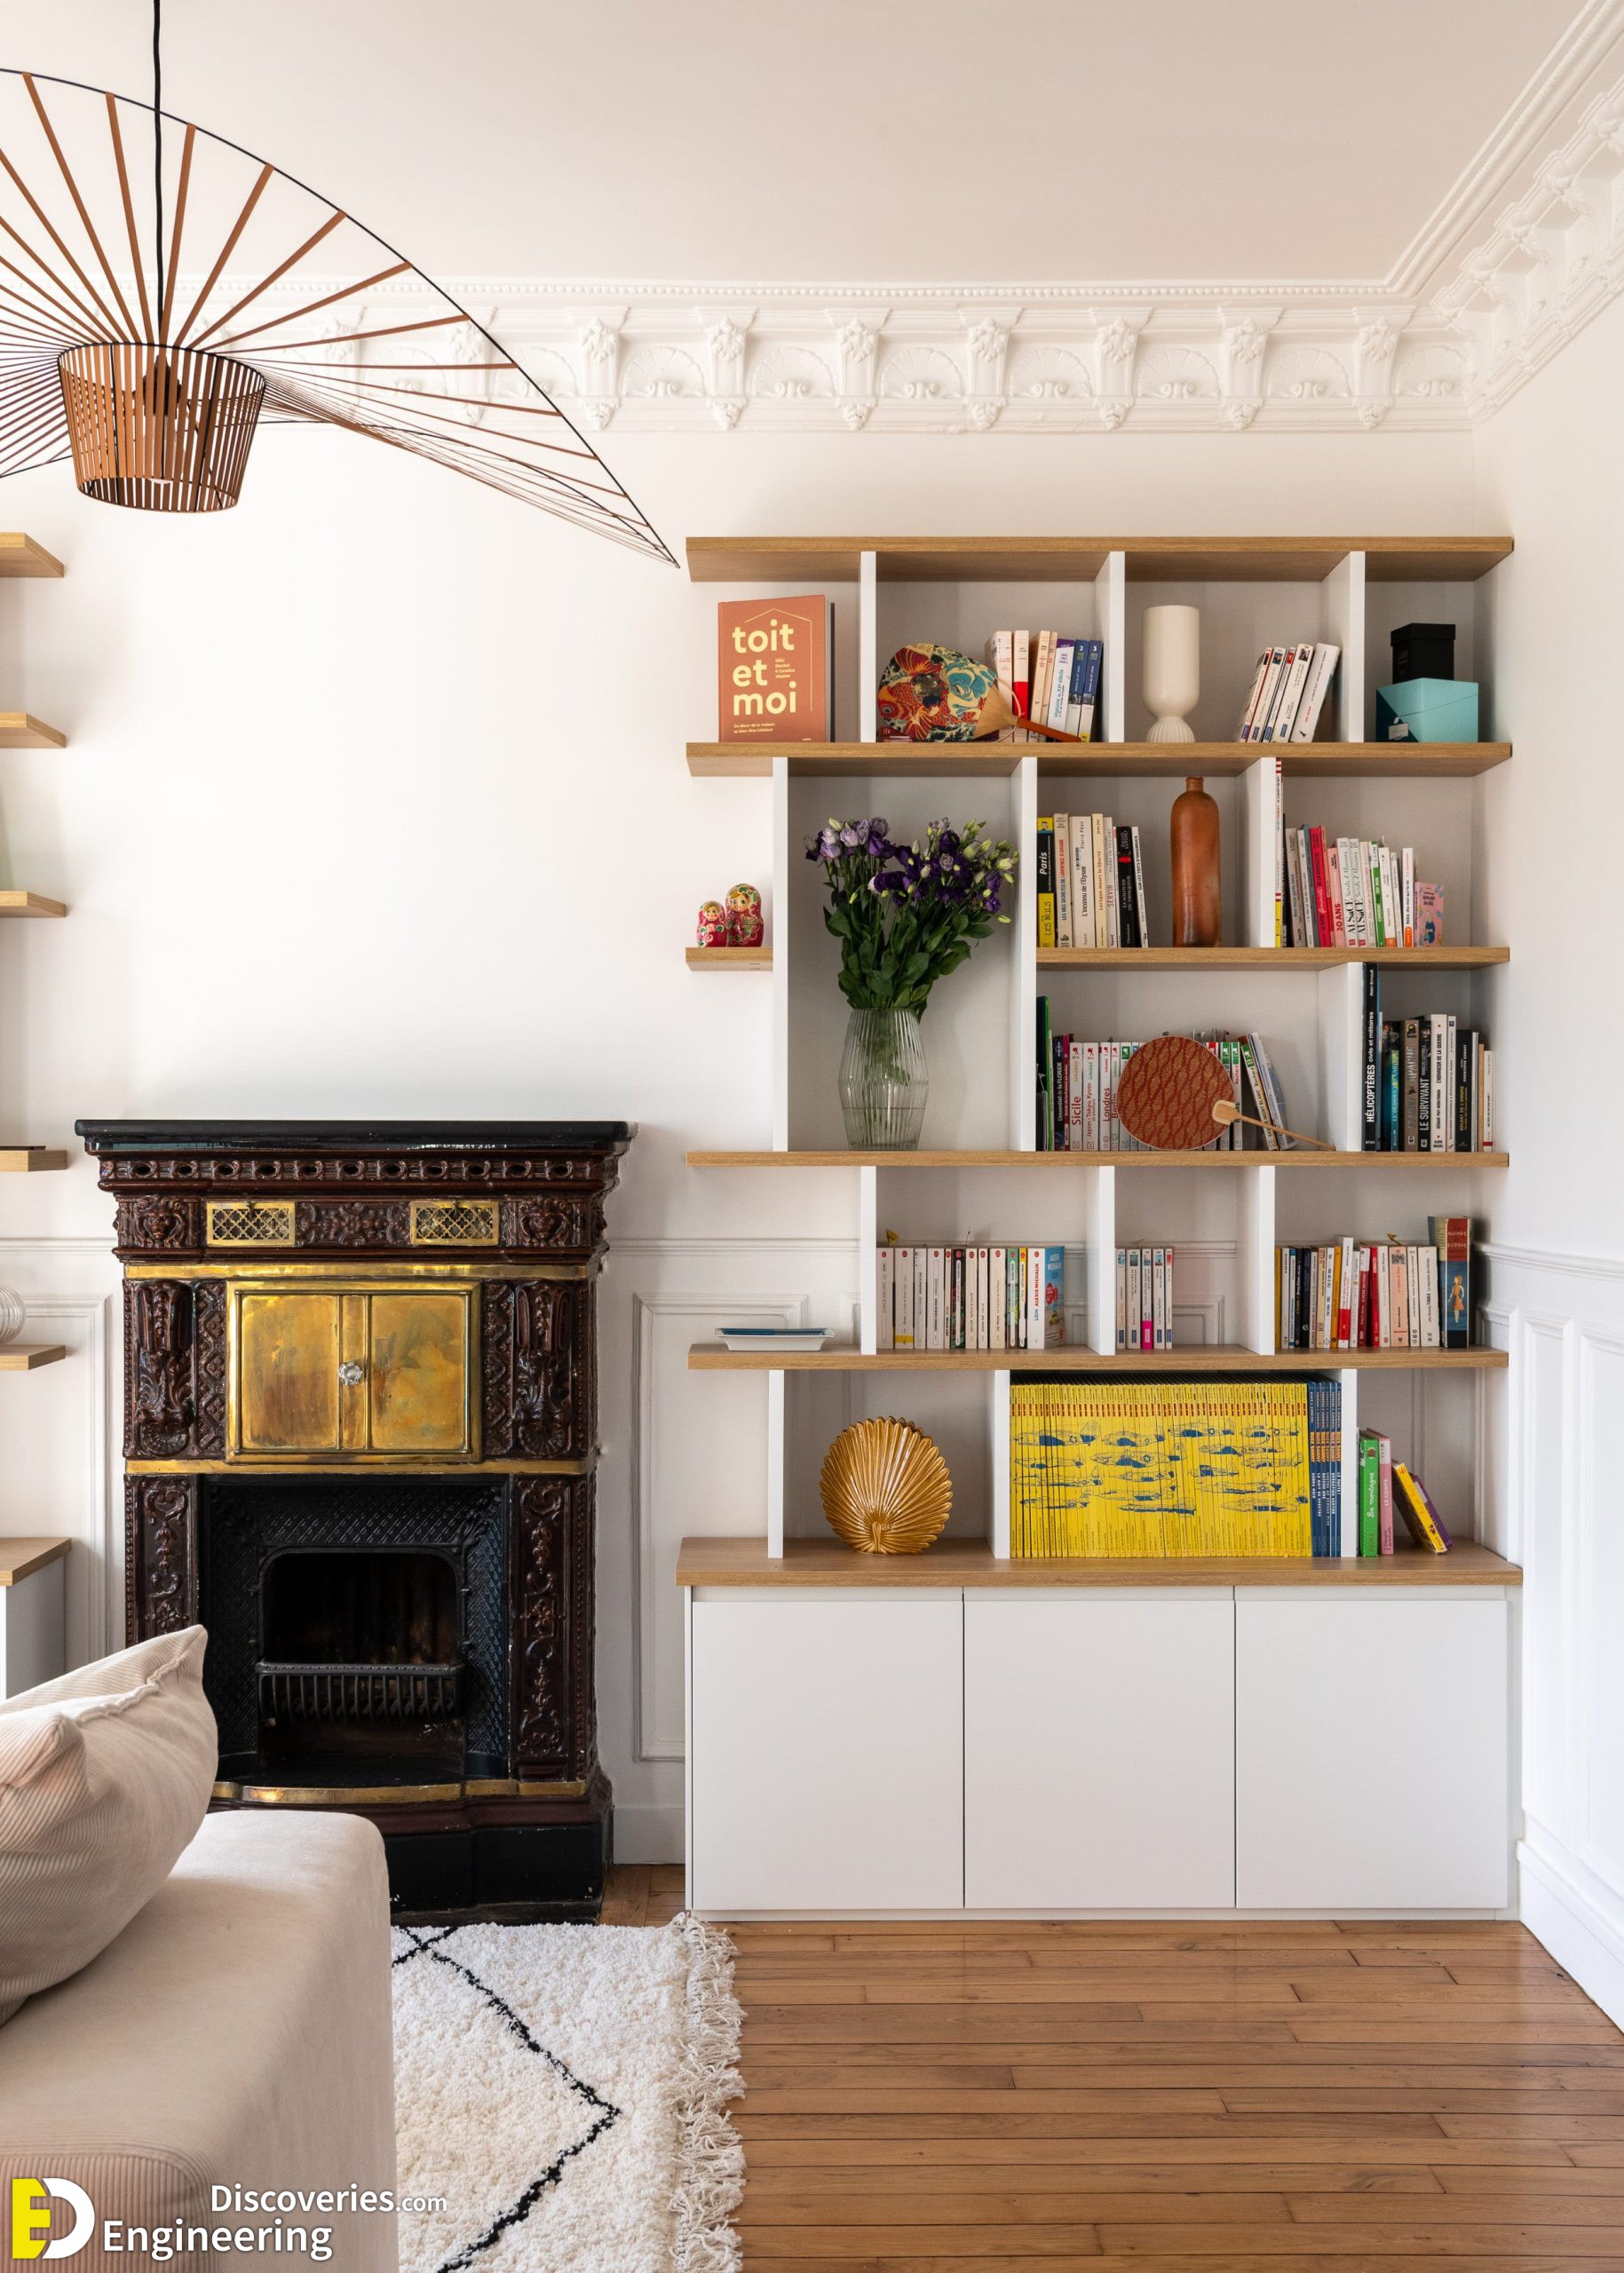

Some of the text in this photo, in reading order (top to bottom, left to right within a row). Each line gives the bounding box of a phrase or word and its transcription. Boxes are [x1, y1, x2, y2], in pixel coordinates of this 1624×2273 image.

[733, 619, 794, 653] toit
[733, 660, 767, 686] et
[733, 681, 796, 716] moi
[1039, 852, 1048, 875] Paris
[1366, 1065, 1375, 1122] HÉLICOPTÈRES
[1420, 1078, 1430, 1130] LE SURVIVANT
[1072, 1097, 1081, 1126] Sicile
[1367, 1508, 1374, 1518] La
